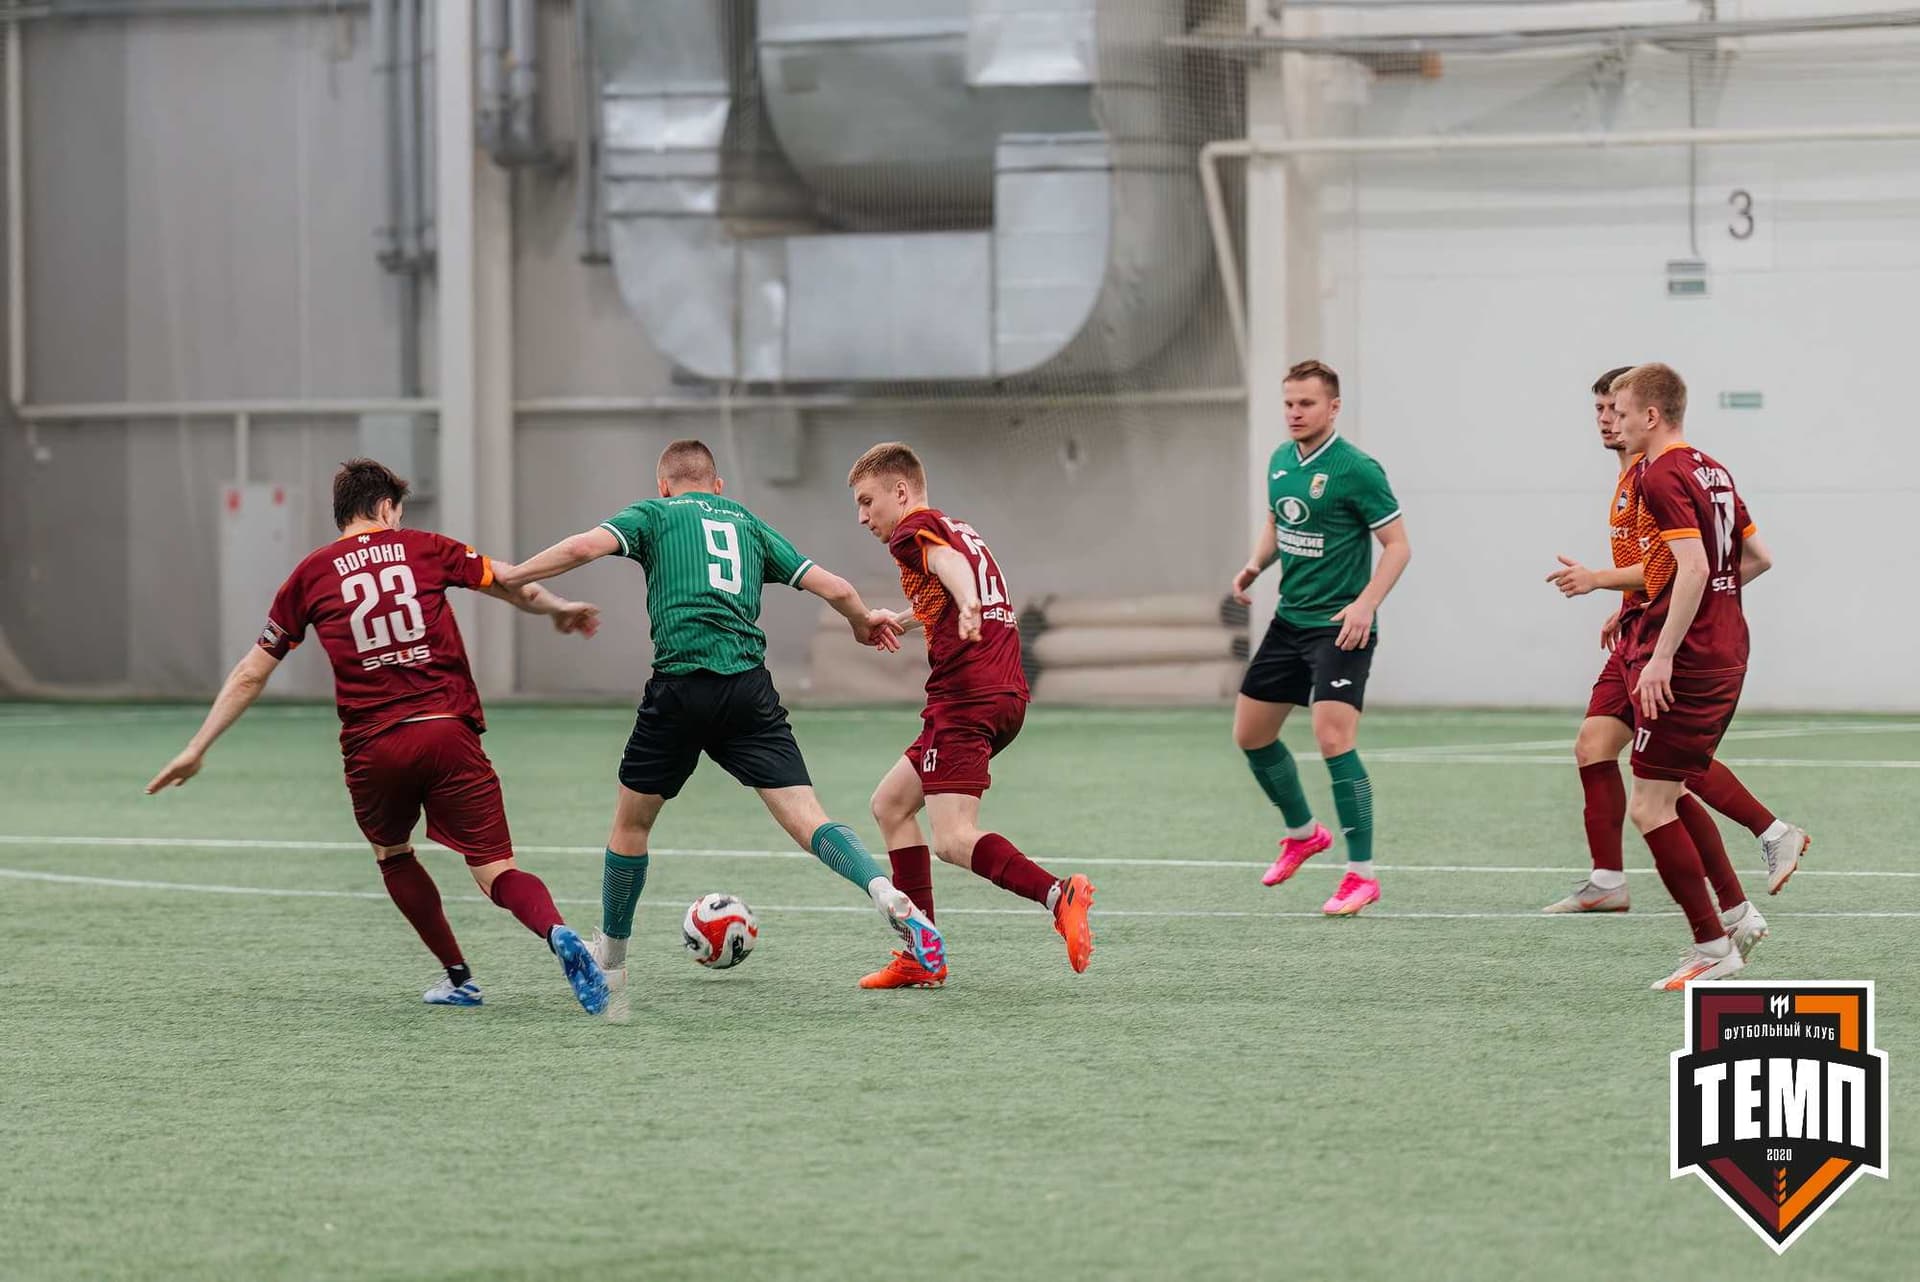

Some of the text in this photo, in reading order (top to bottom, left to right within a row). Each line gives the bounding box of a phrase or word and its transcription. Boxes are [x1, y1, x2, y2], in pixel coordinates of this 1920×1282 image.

[1728, 189, 1754, 240] 3
[333, 543, 406, 577] ВОРОНА
[701, 518, 741, 595] 9
[340, 564, 426, 654] 23
[923, 748, 938, 772] 27
[1634, 727, 1652, 753] 17
